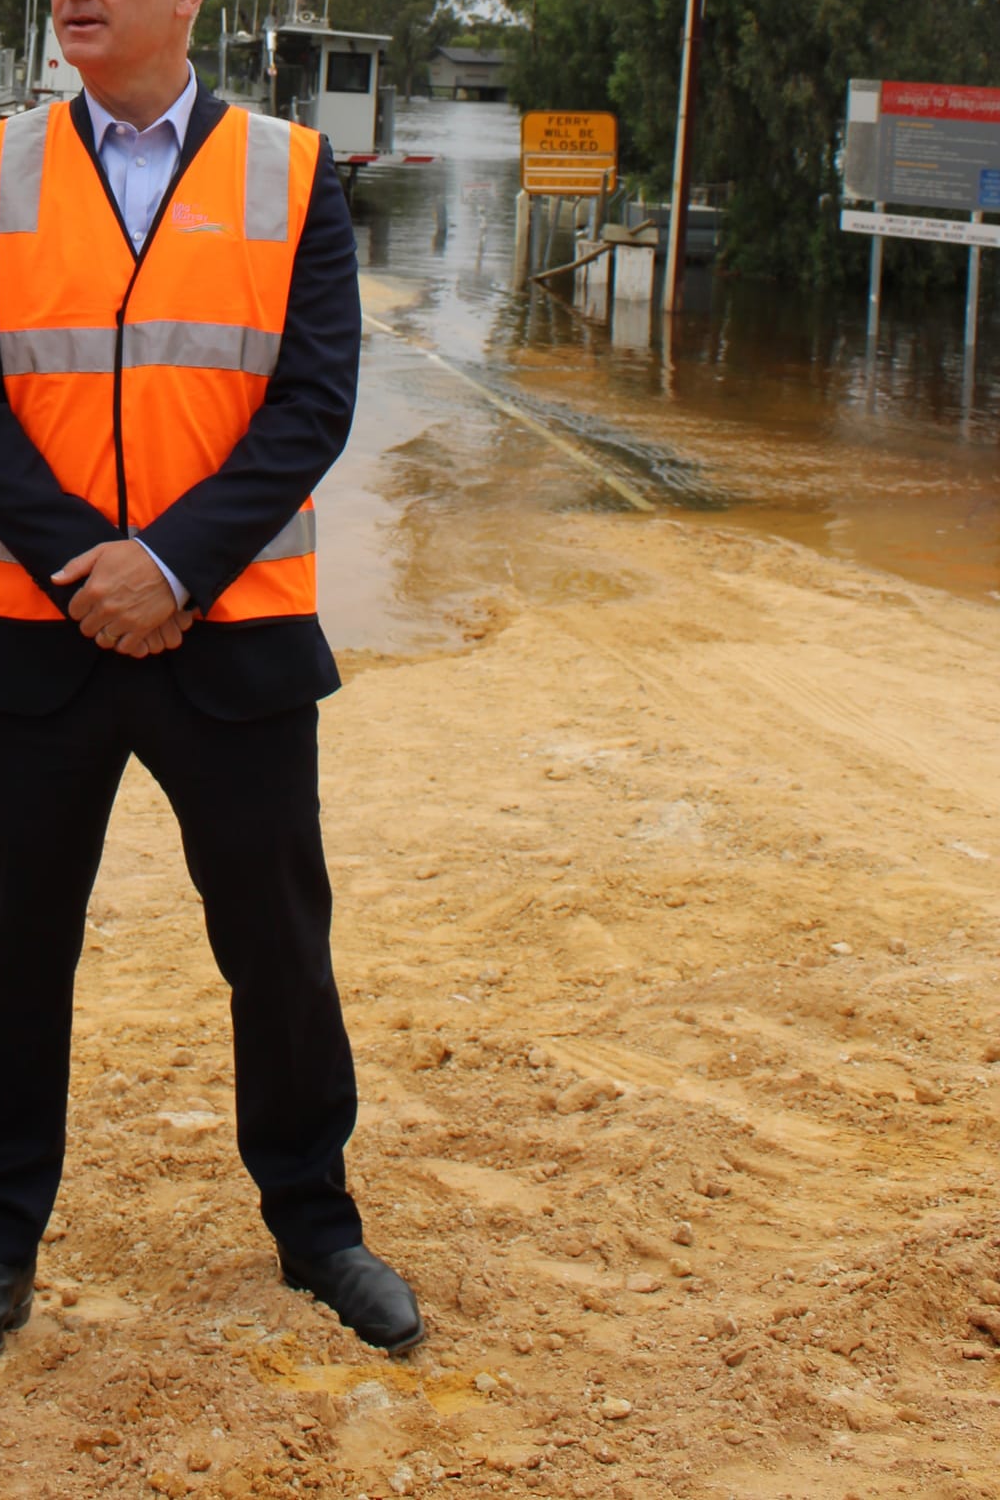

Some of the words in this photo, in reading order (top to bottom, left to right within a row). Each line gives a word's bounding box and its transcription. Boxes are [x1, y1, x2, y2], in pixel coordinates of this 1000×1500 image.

[547, 116, 590, 126] FERRY
[544, 128, 571, 139] WILL
[578, 129, 594, 139] BE
[539, 140, 599, 152] CLOSED
